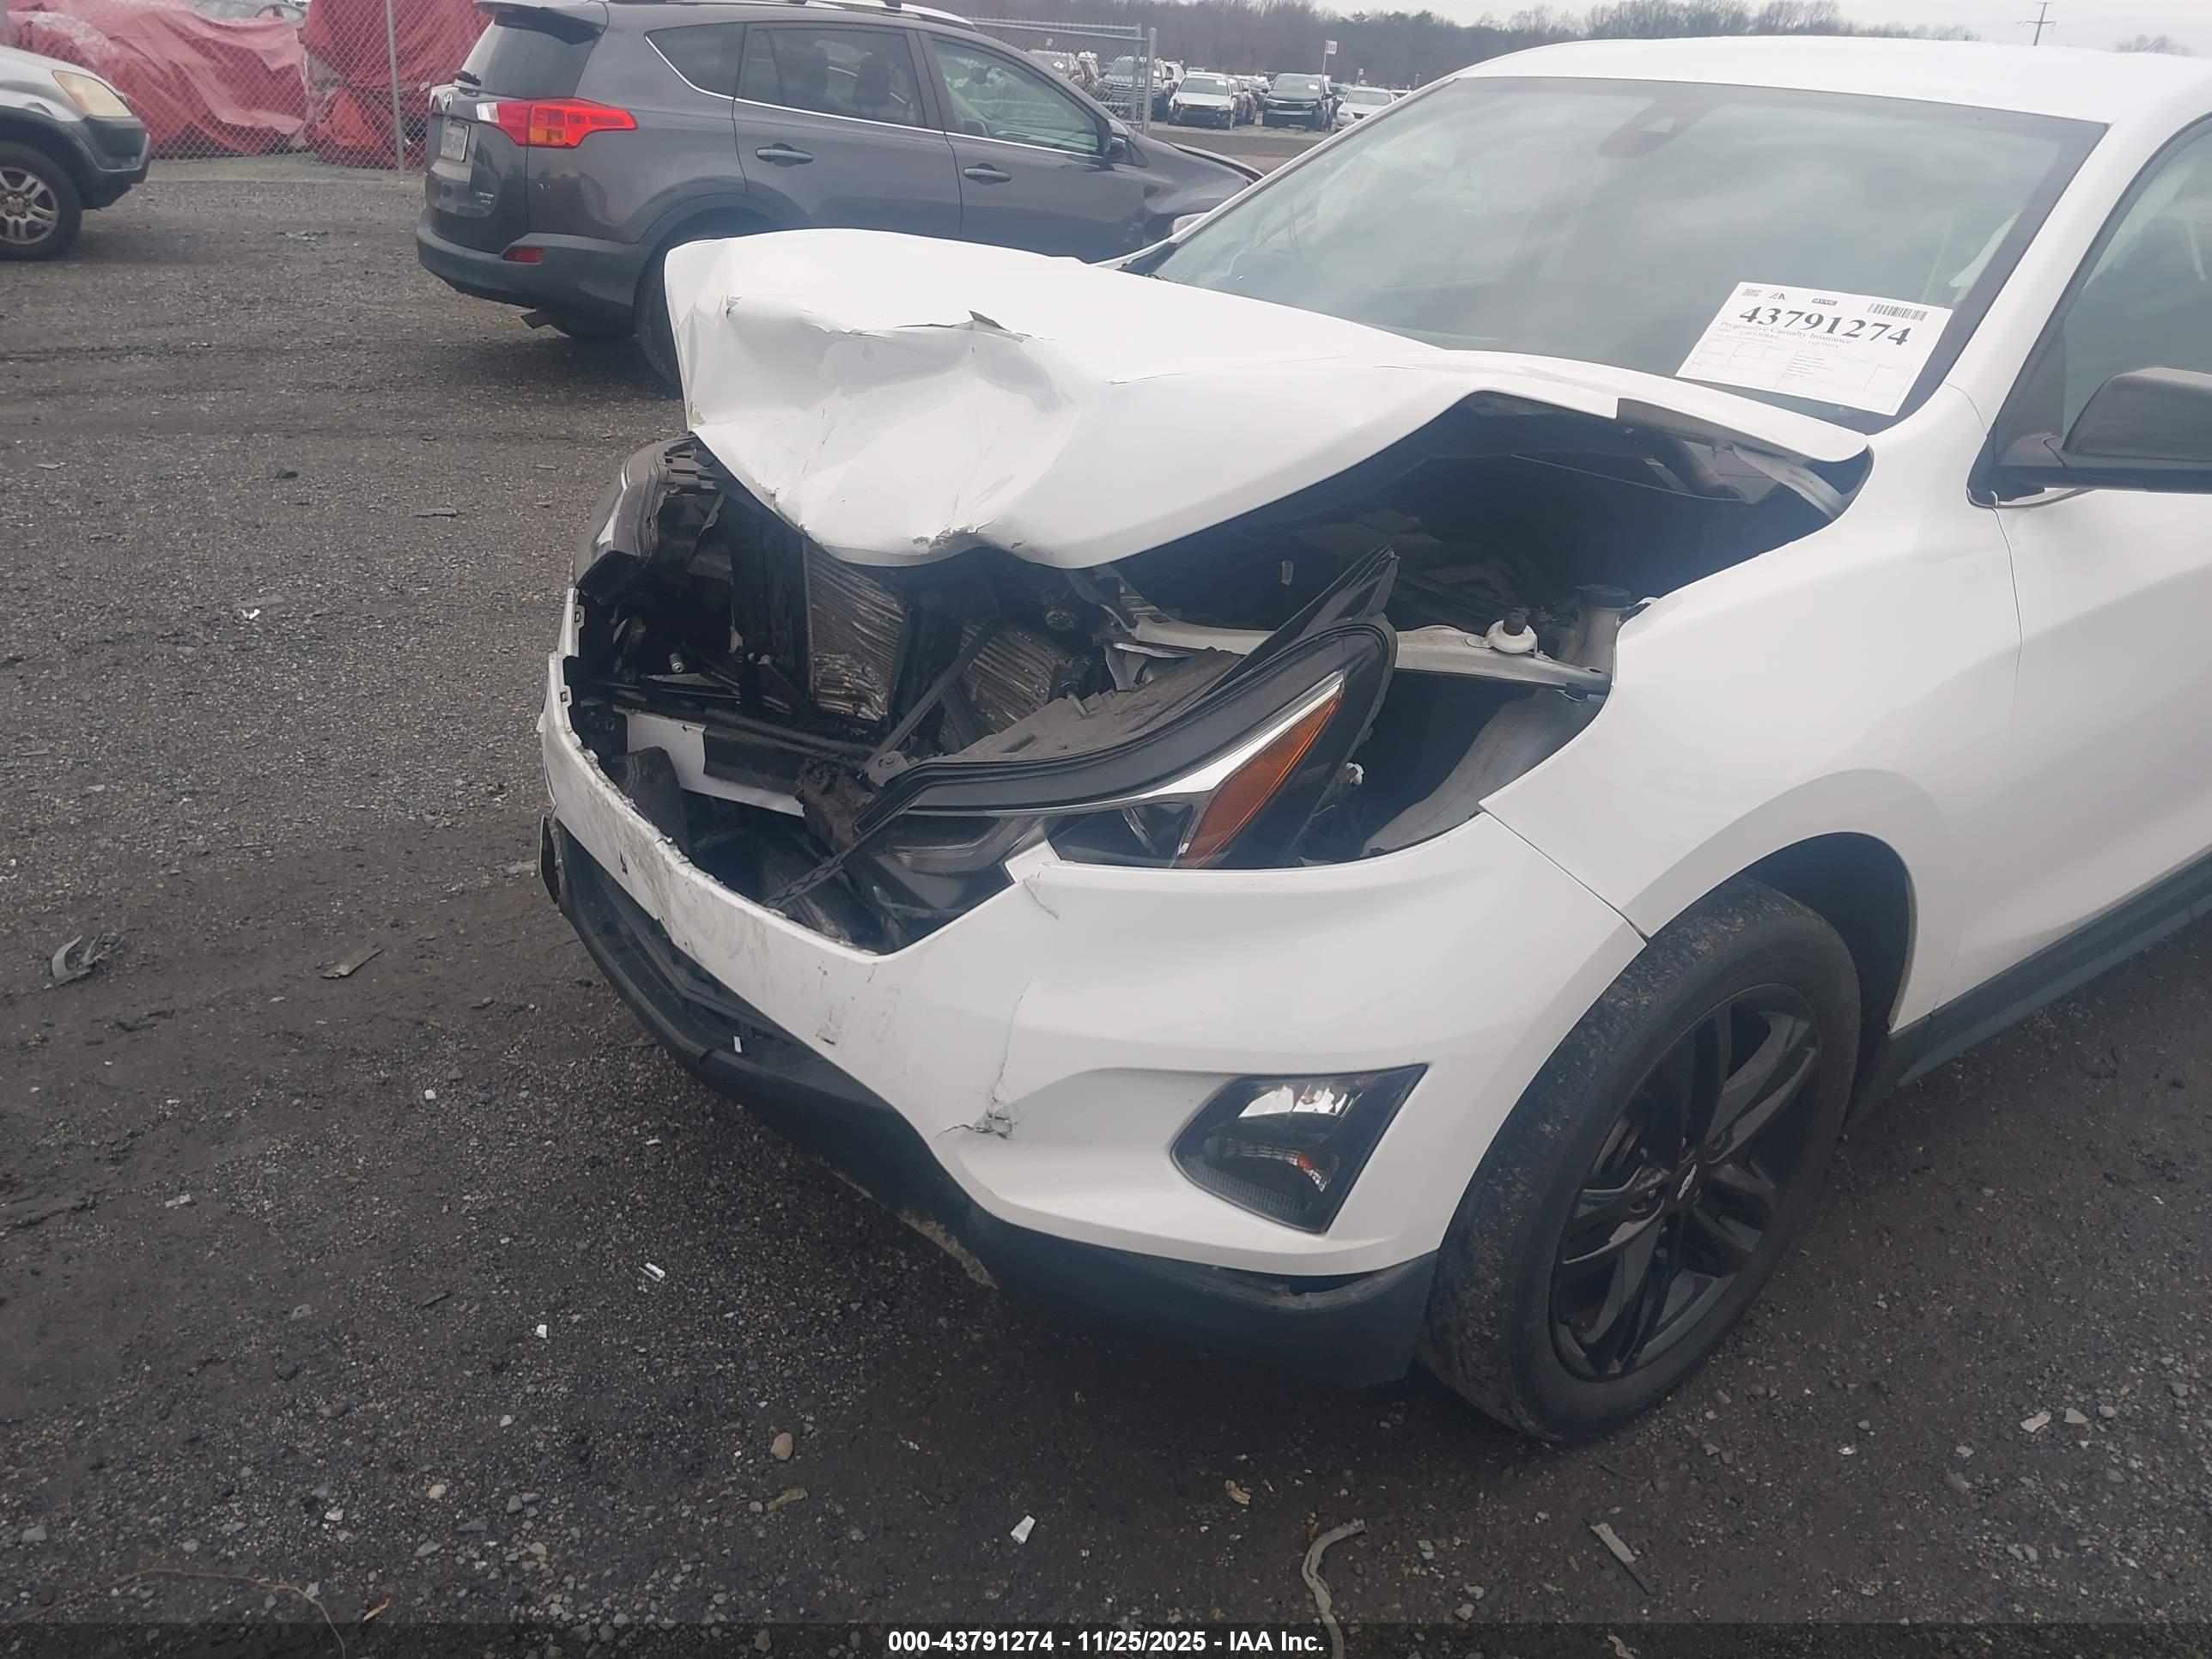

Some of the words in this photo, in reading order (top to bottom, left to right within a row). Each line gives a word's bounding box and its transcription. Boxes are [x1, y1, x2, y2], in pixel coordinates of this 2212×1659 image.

[1739, 306, 1912, 346] 43791274
[1770, 326, 1806, 338] Casualty
[1808, 332, 1853, 345] Insurance
